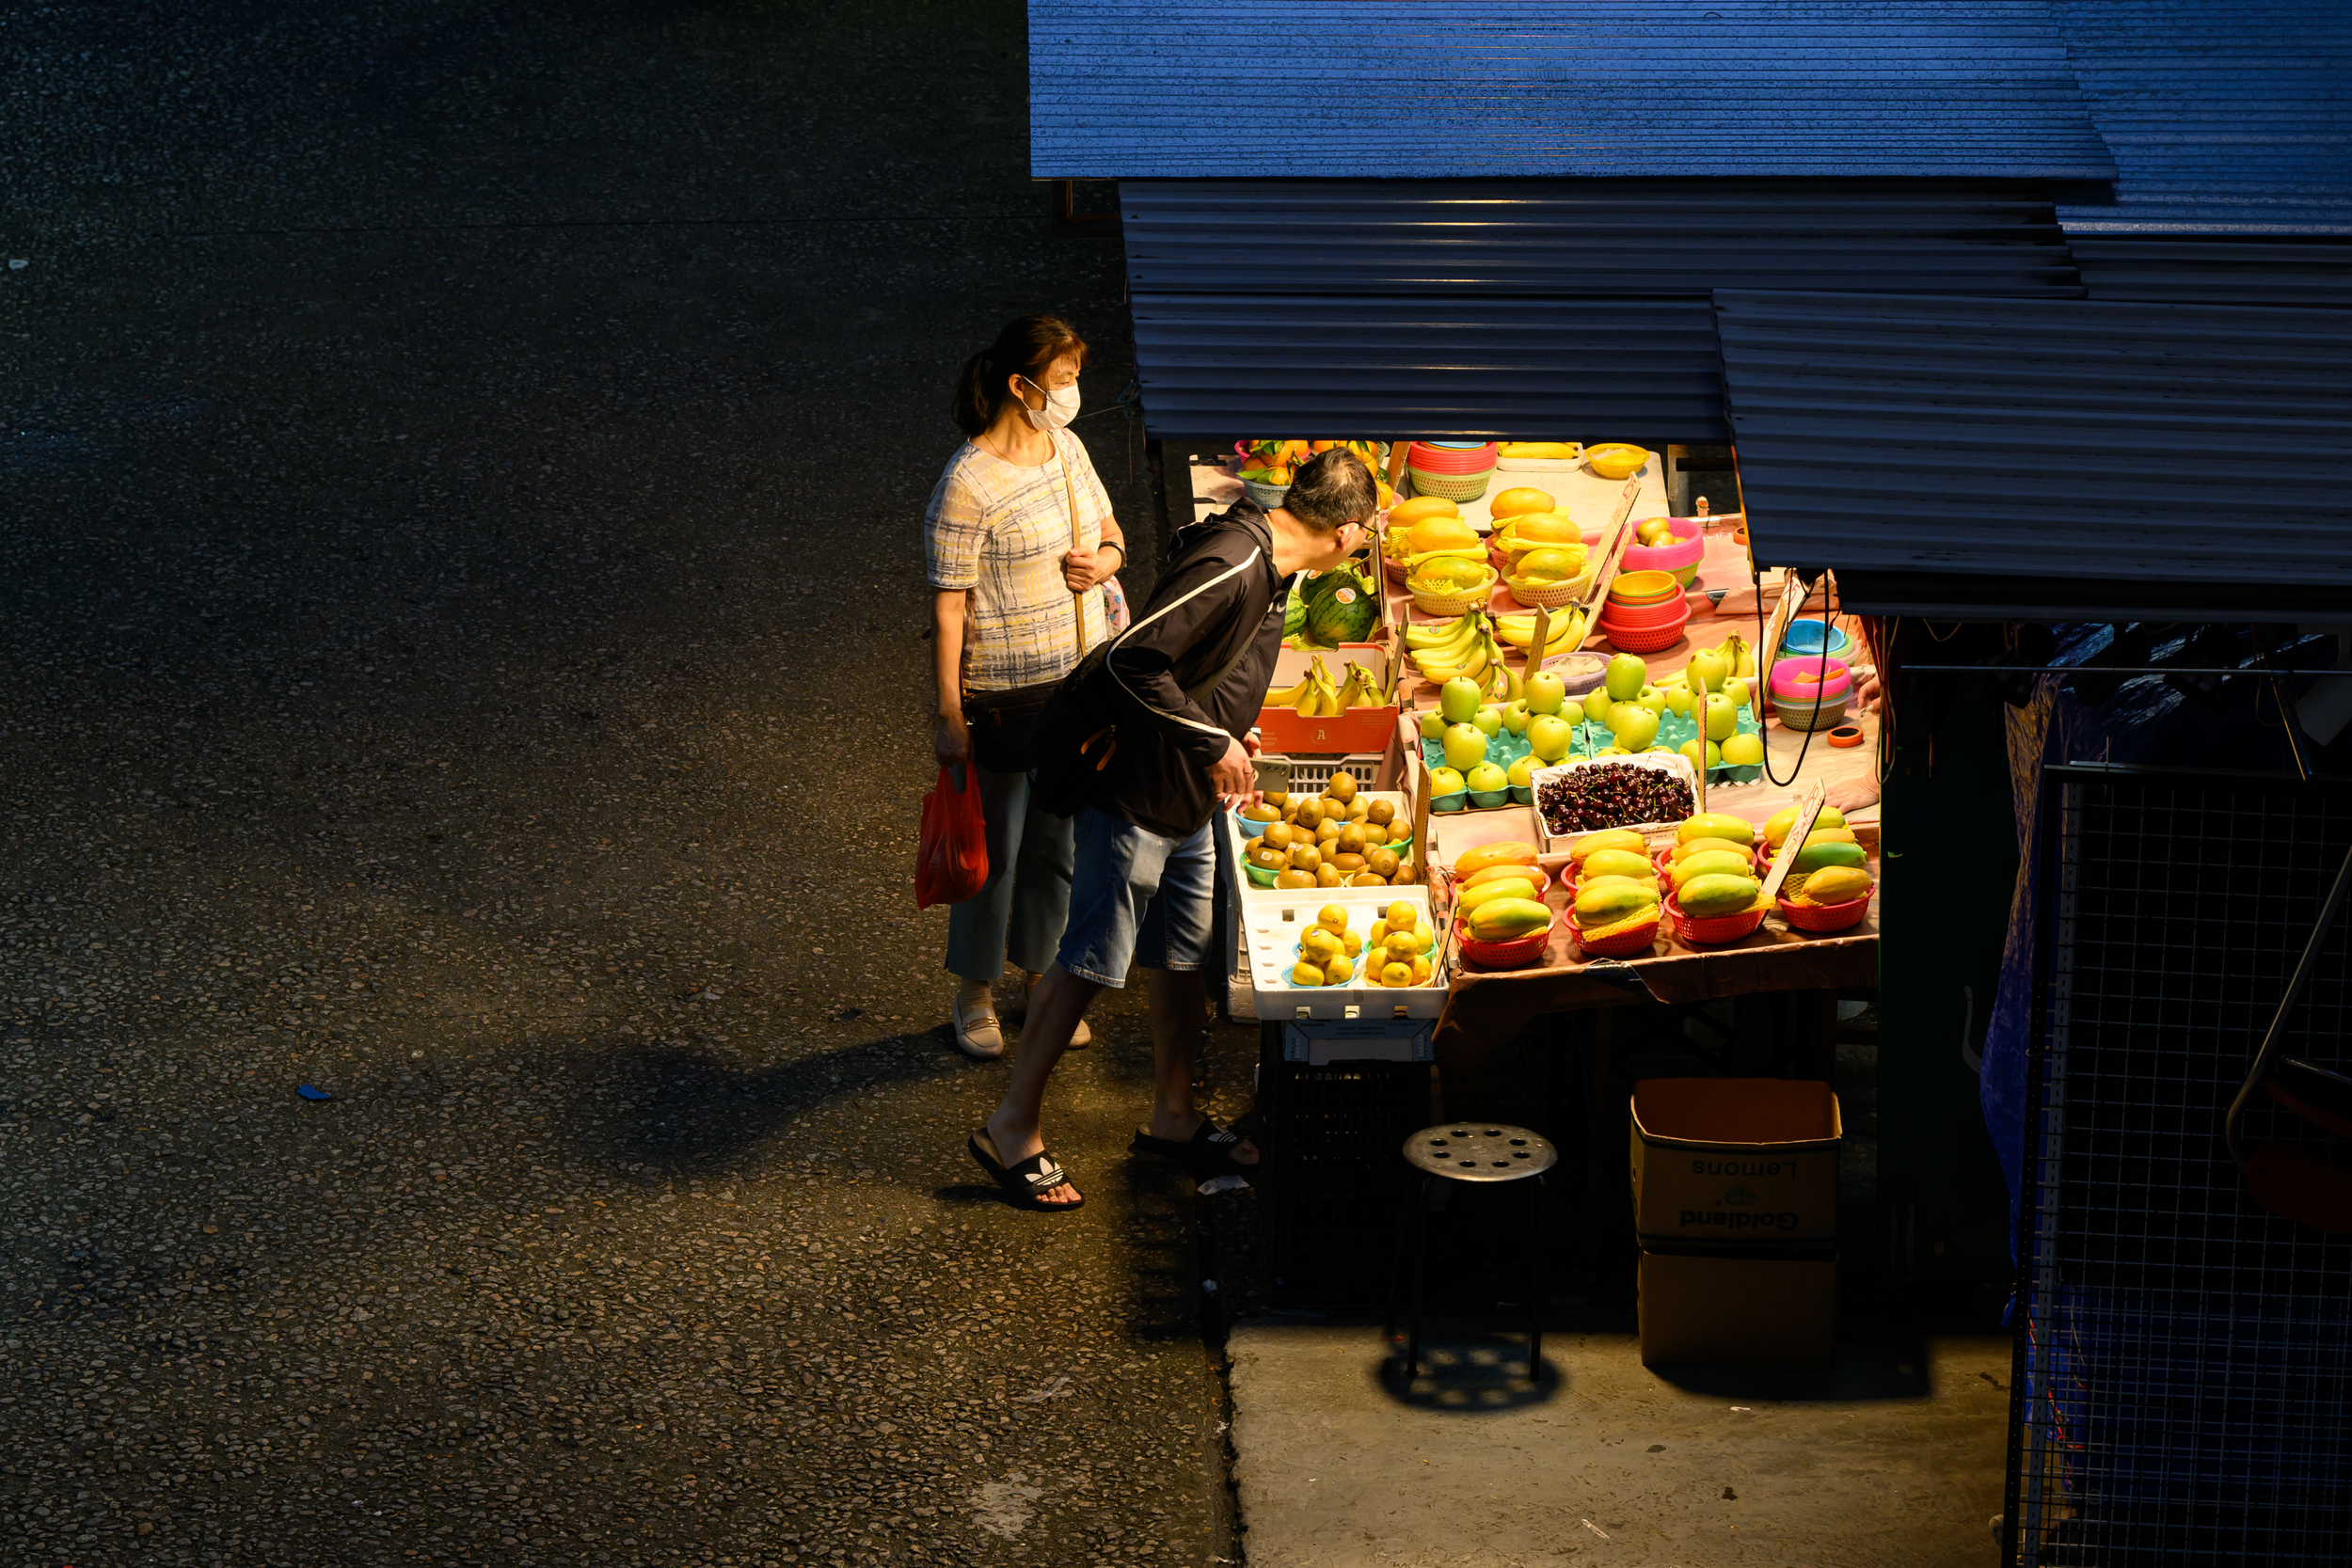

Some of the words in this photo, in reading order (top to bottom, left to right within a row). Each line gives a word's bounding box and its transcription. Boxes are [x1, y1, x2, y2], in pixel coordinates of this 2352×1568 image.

[1622, 473, 1637, 500] 25
[1317, 729, 1327, 740] A
[1802, 781, 1820, 817] 18
[1692, 1160, 1796, 1179] Lemons
[1679, 1211, 1799, 1230] Goldland
